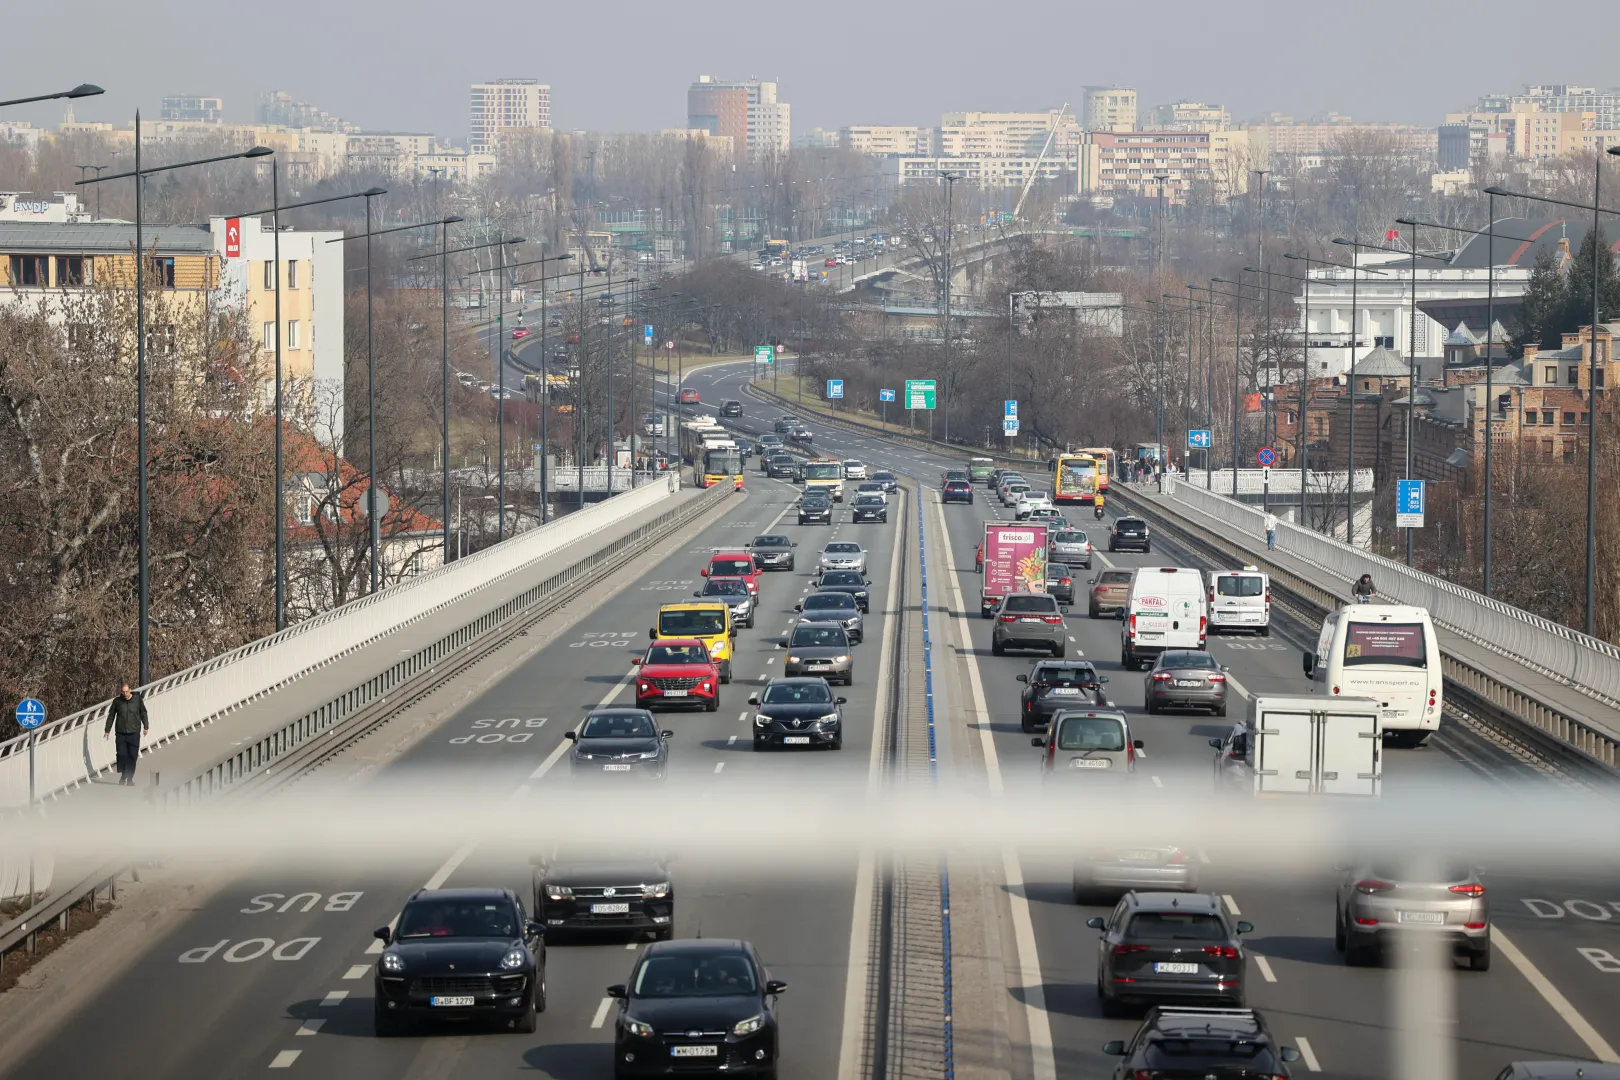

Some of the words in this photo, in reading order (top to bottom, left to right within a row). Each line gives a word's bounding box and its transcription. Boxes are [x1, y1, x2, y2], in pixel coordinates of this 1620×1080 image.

[14, 201, 49, 214] HWDP
[1002, 533, 1030, 542] frisco.pl
[1141, 598, 1163, 606] PAKFAL
[471, 718, 548, 729] BUS
[449, 733, 535, 744] DOP
[240, 891, 364, 914] BUS
[1520, 899, 1620, 920] DO
[178, 937, 322, 963] DOP
